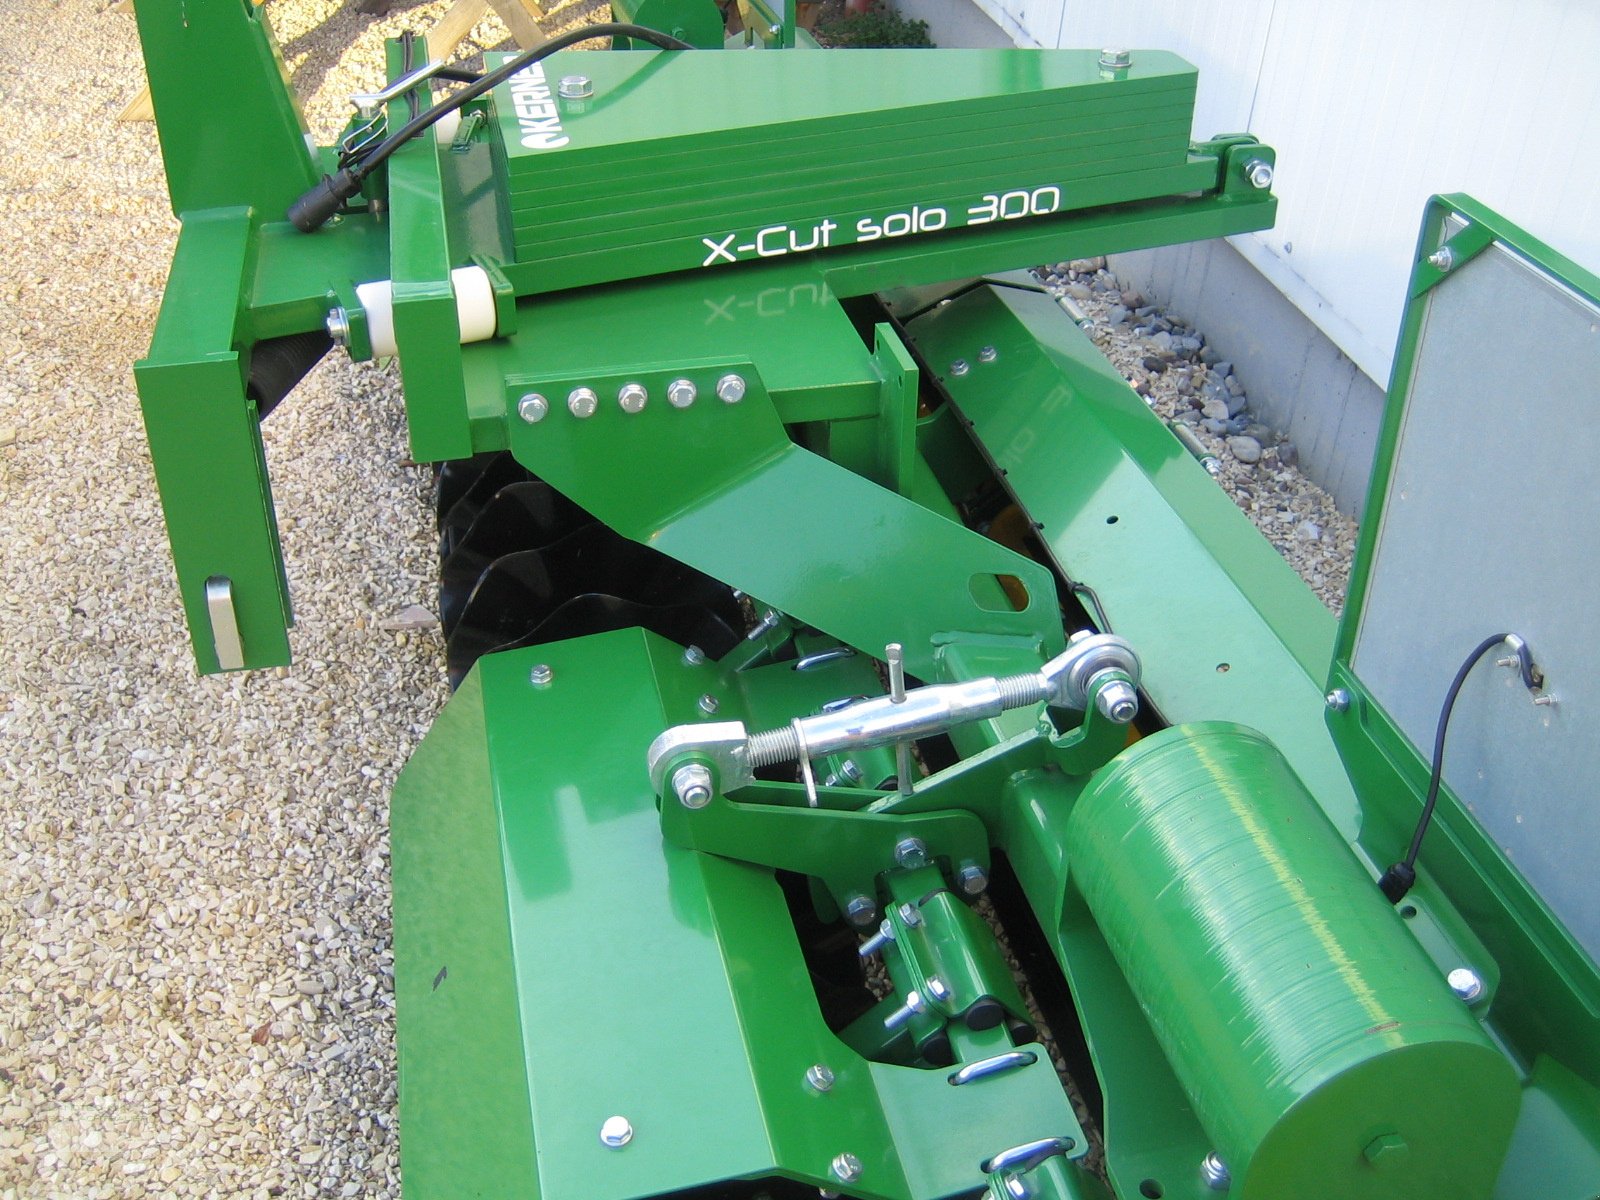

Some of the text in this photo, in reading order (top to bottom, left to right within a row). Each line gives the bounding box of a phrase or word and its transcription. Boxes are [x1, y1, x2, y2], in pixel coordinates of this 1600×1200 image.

[503, 55, 562, 134] KERNE
[702, 186, 1060, 267] X-Cut solo 300
